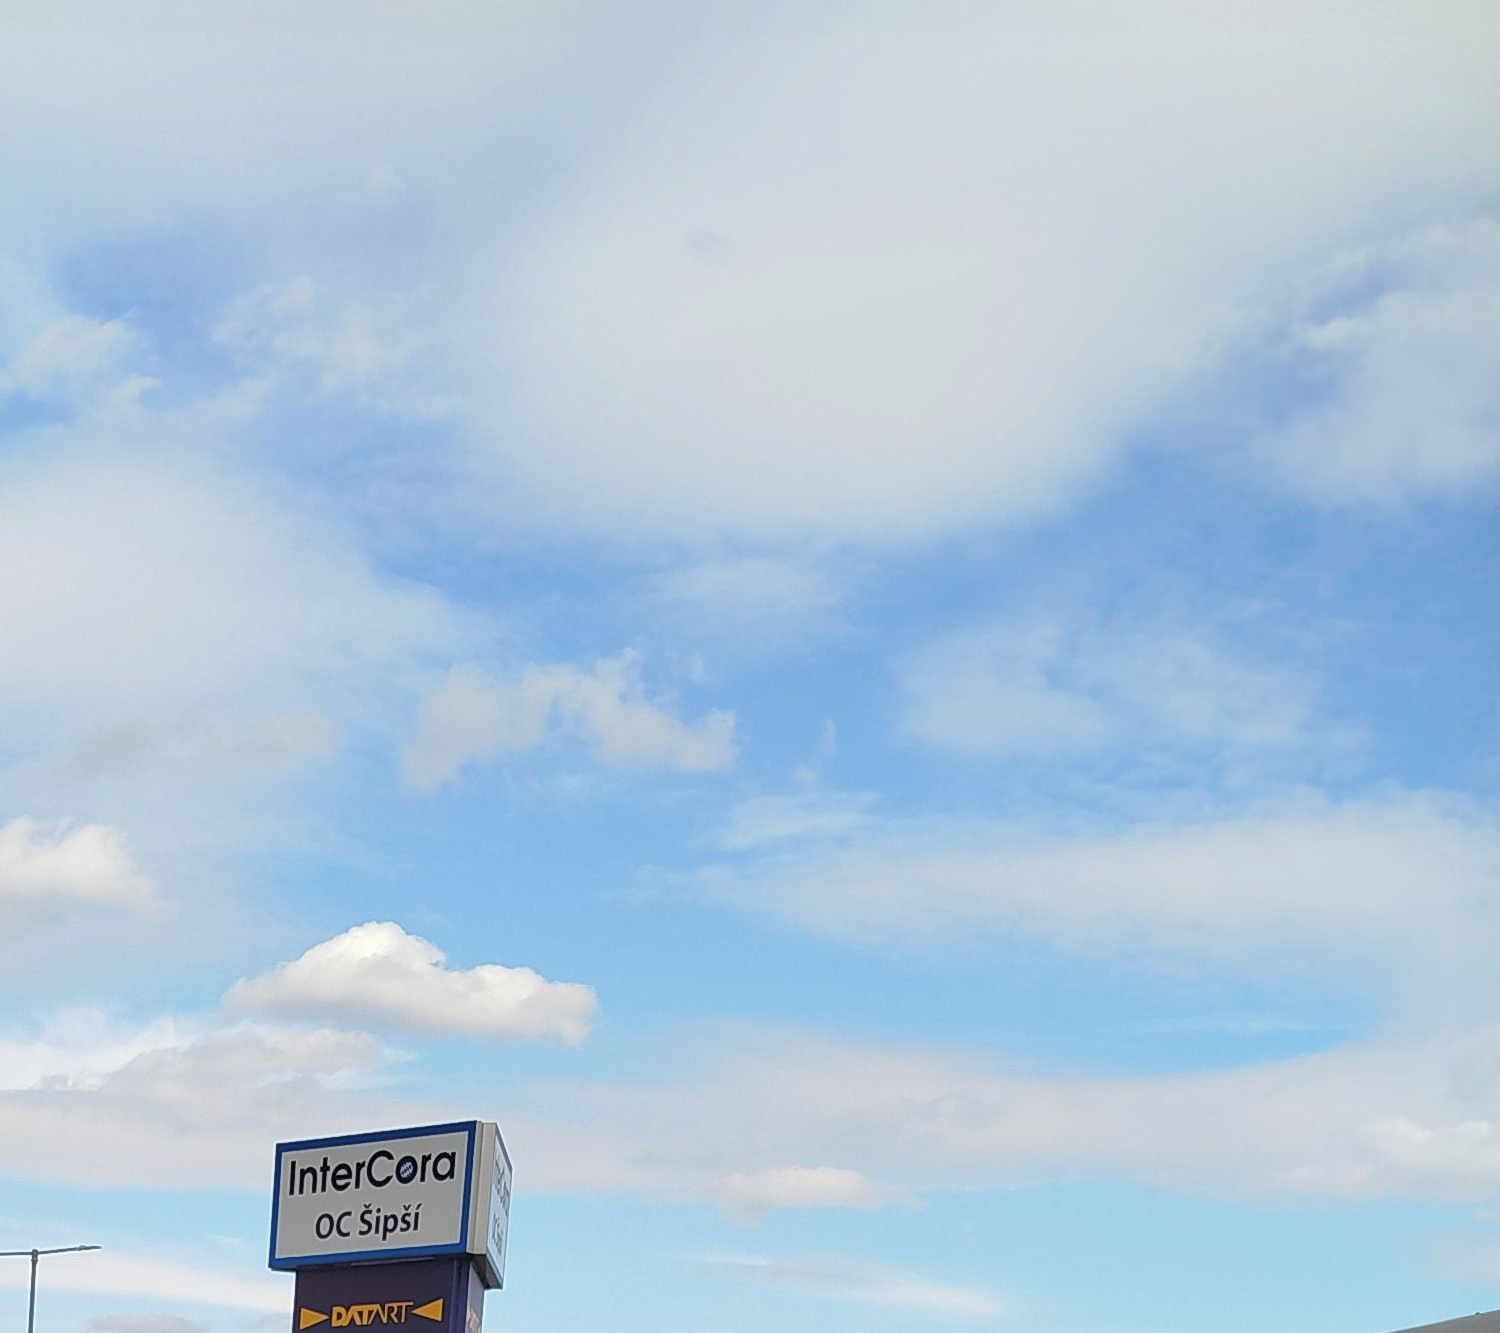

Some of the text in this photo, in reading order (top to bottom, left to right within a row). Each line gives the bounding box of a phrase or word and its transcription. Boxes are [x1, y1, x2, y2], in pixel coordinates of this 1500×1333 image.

[288, 1149, 457, 1196] InterCora
[315, 1203, 423, 1242] OC Šipší
[331, 1301, 414, 1328] DATART
